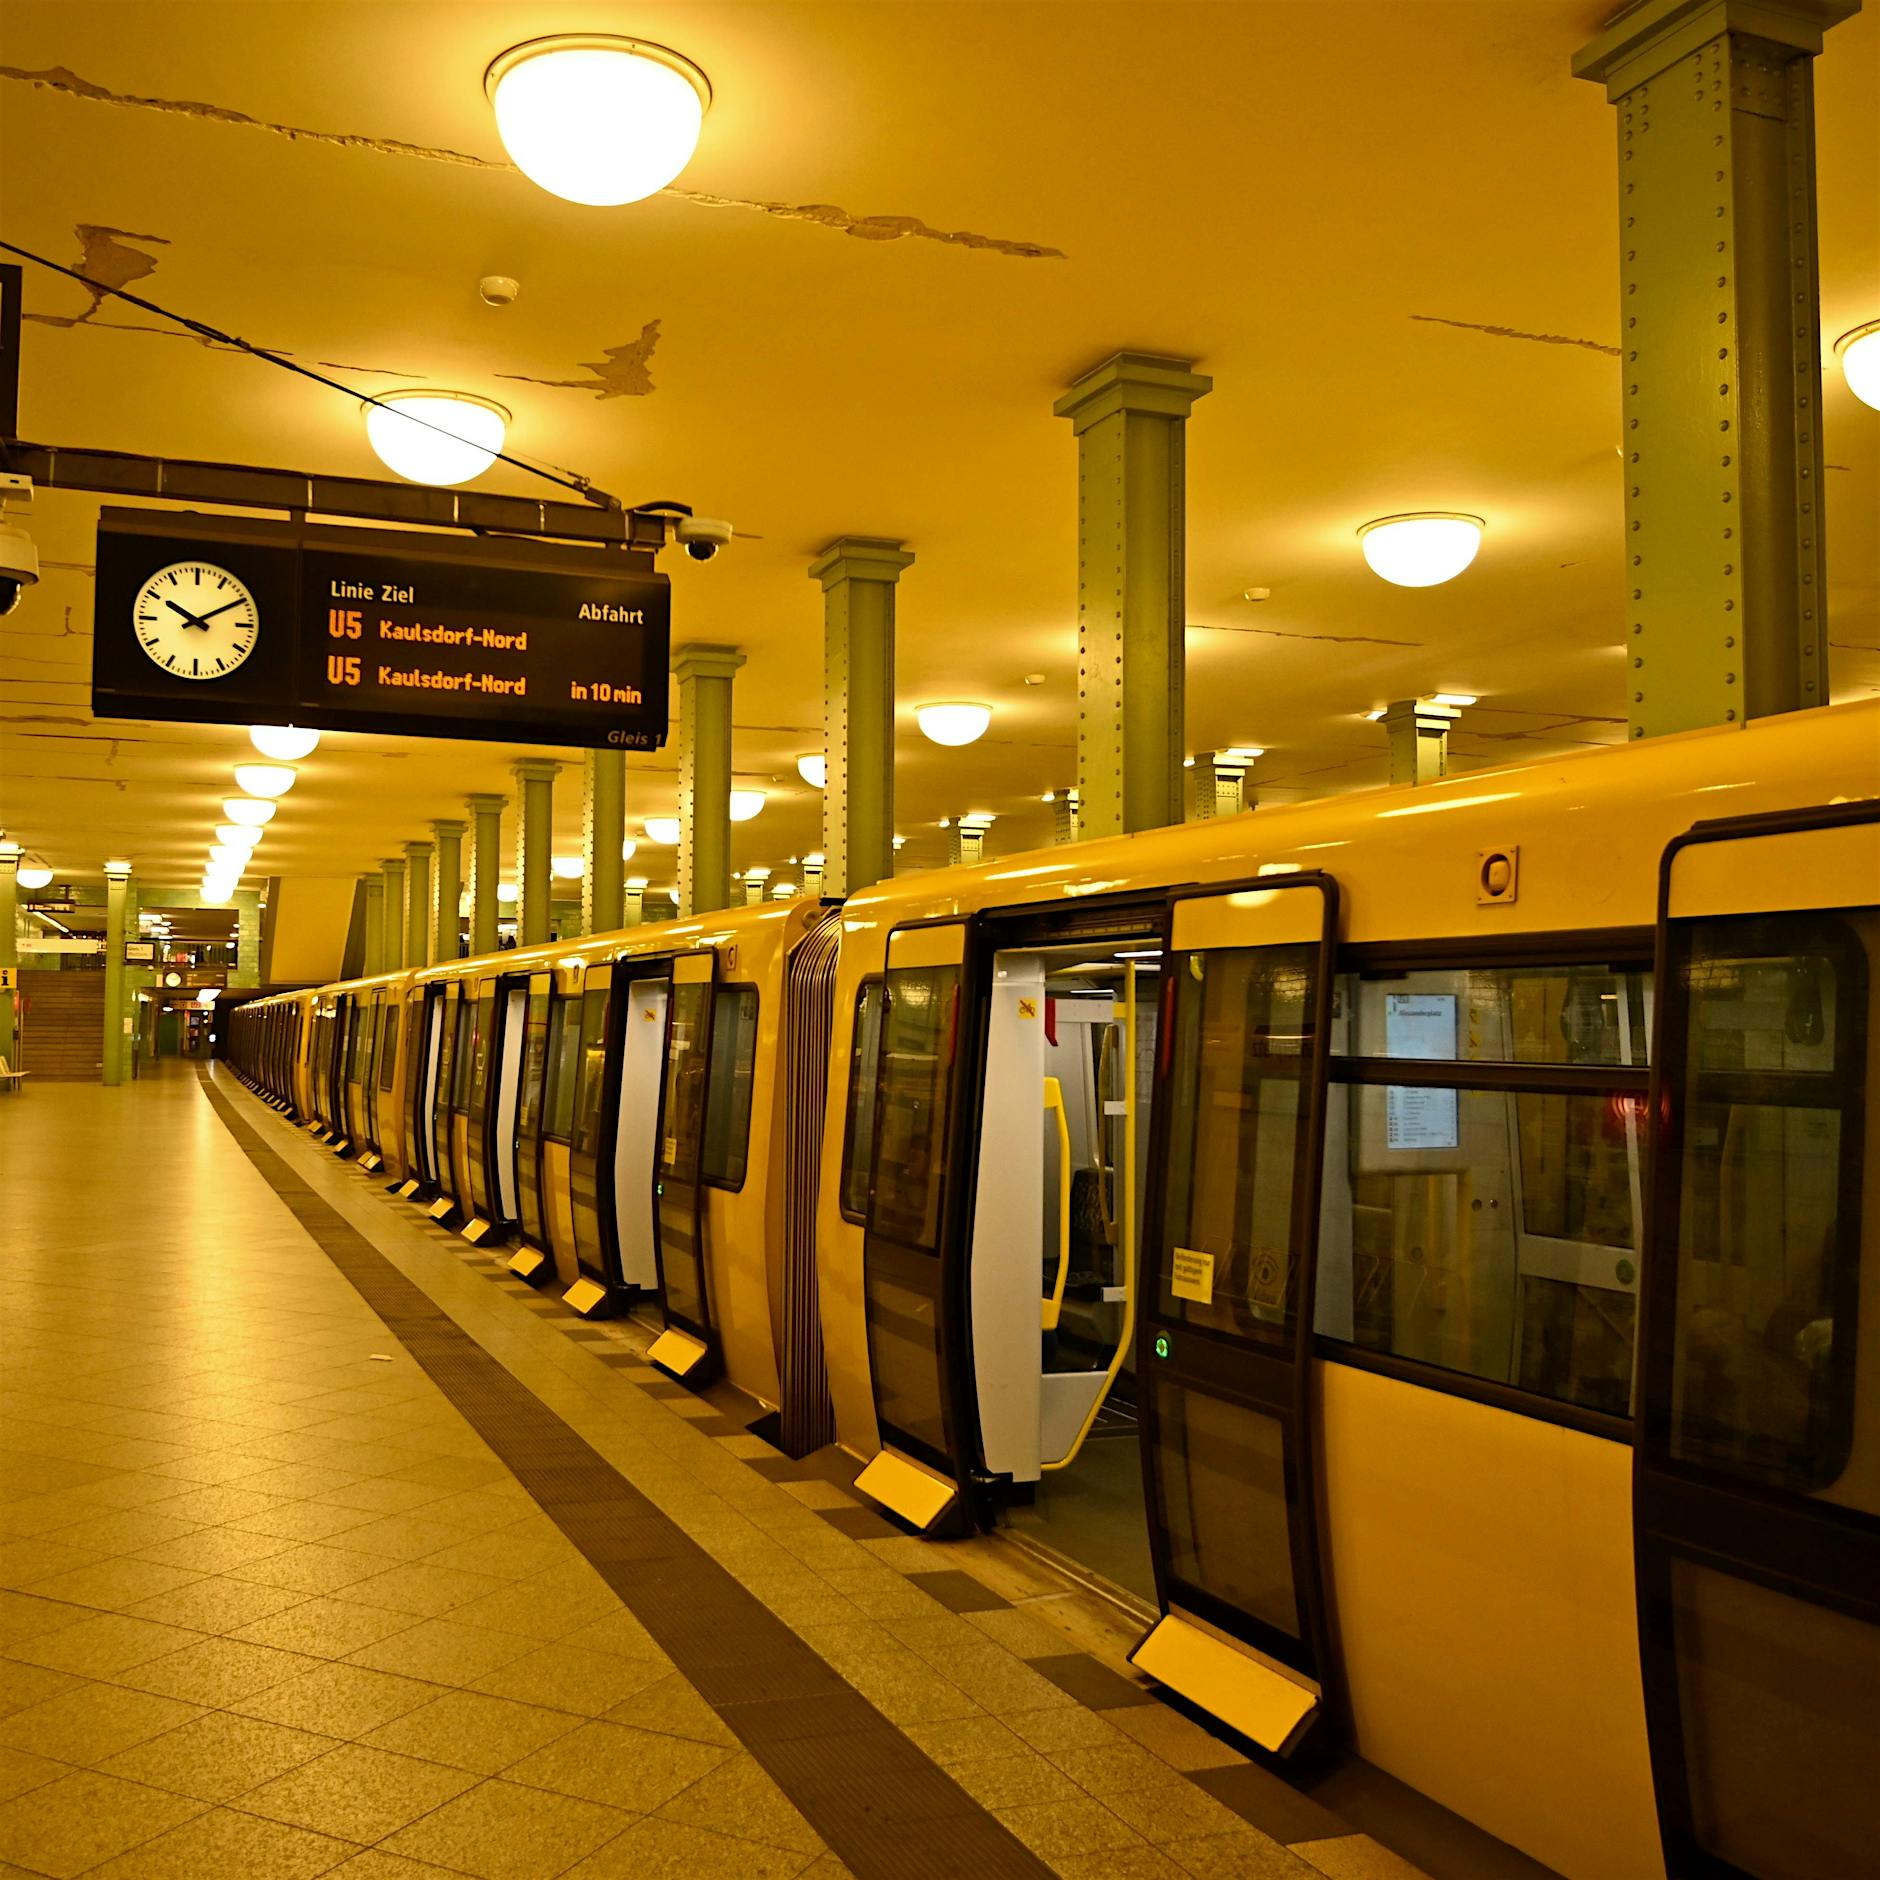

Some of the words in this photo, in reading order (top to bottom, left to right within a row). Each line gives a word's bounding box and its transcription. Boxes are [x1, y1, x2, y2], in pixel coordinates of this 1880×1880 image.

[331, 580, 374, 600] Linie
[381, 585, 414, 603] Ziel
[578, 603, 644, 625] Abfahrt
[328, 609, 363, 639] U5
[379, 620, 527, 650] Kaulsdorf-Nord
[327, 655, 362, 686] U5
[378, 666, 526, 695] Kaulsdorf-Nord
[571, 681, 588, 700] in
[590, 683, 611, 702] 10
[613, 686, 642, 705] min
[607, 730, 649, 745] Gleis
[655, 734, 662, 745] 1
